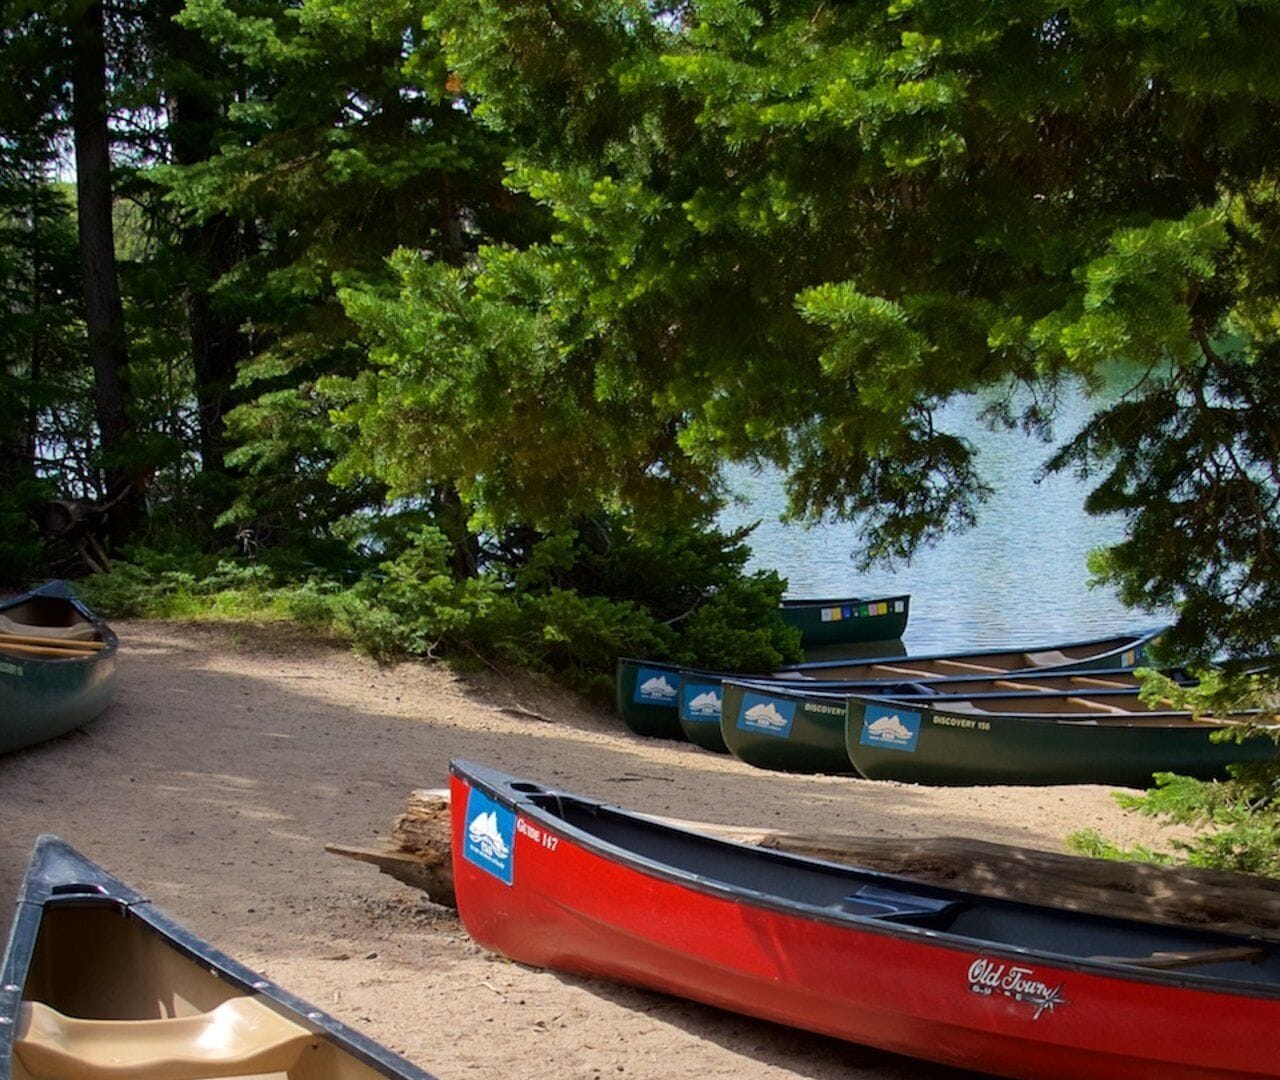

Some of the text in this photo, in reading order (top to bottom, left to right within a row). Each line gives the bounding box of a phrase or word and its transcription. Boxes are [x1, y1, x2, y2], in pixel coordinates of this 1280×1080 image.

[933, 715, 976, 728] DISCOVERY
[968, 959, 1005, 987] Old
[1001, 966, 1052, 1000] Town
